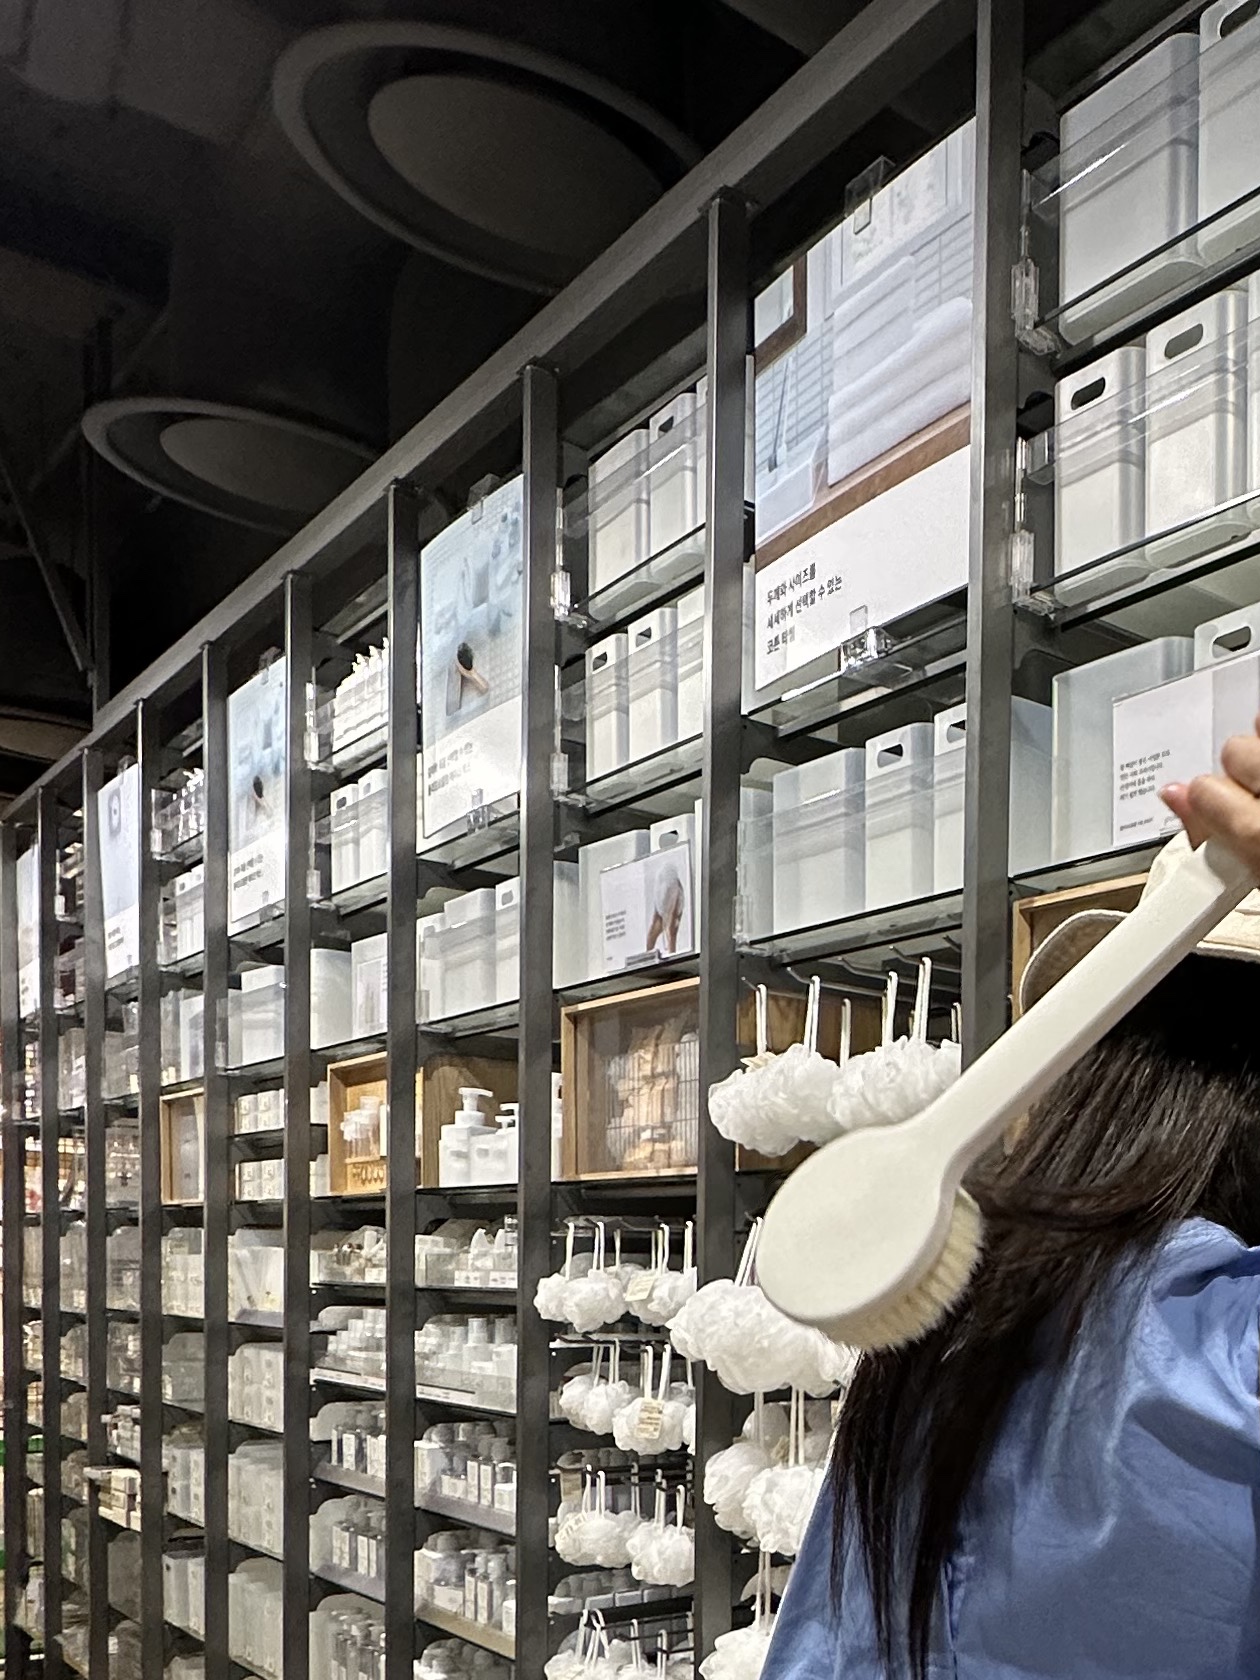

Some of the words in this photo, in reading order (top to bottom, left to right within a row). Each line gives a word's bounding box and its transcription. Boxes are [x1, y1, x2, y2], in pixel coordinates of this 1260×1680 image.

[789, 562, 816, 592] 사이즈를
[818, 584, 826, 600] 수
[827, 575, 843, 595] 있는
